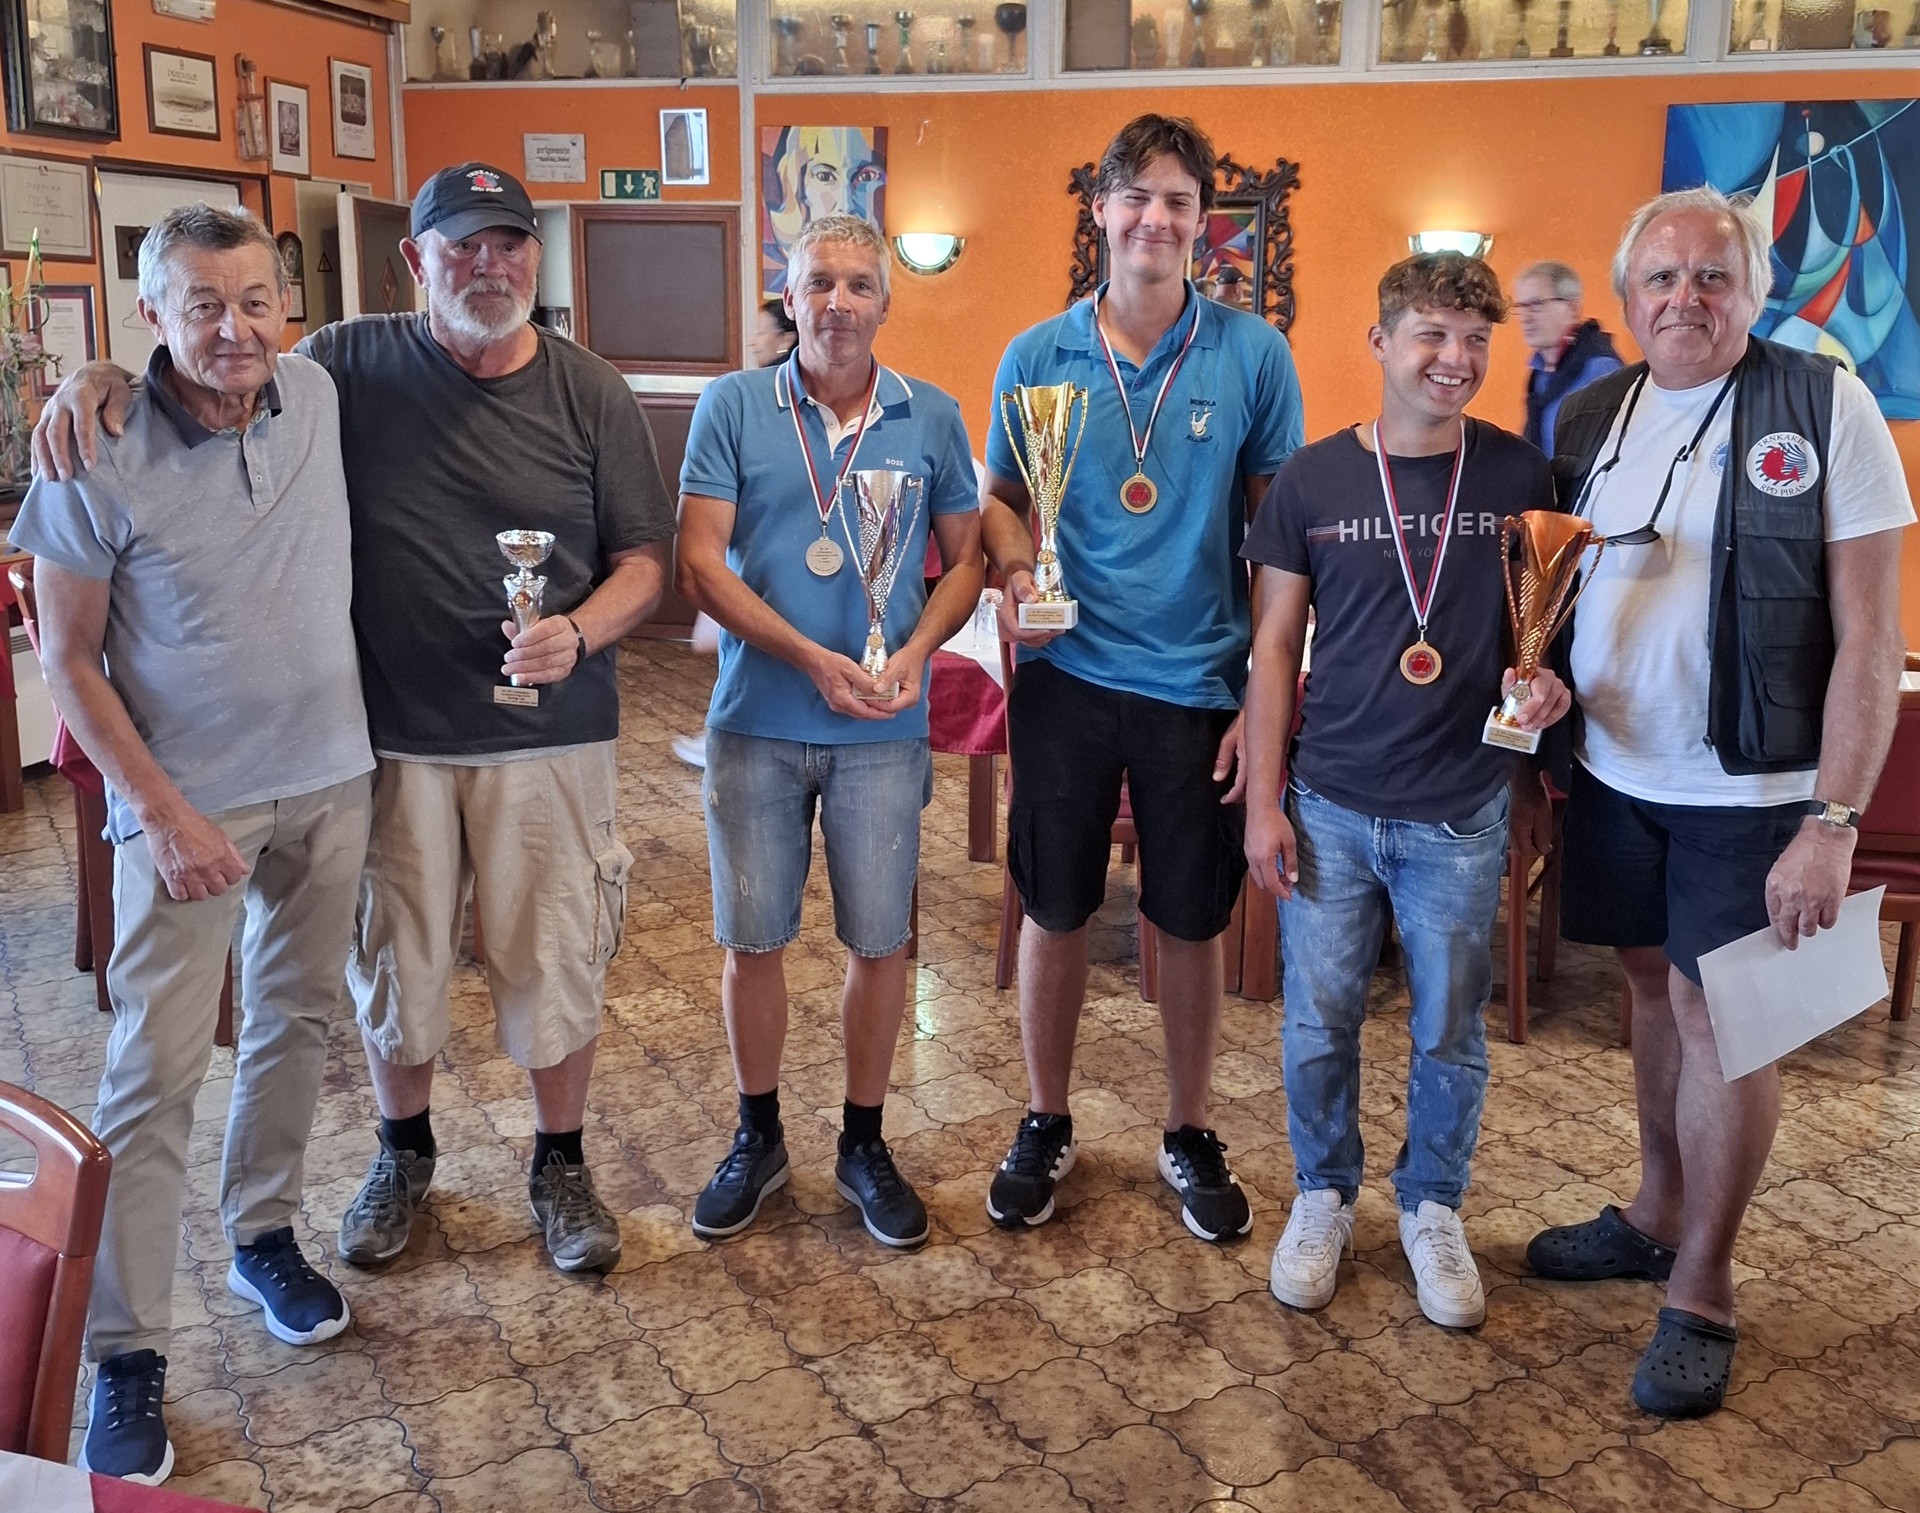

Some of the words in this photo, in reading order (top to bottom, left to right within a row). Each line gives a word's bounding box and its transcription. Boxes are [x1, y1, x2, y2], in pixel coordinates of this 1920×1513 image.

[1757, 434, 1805, 448] TRNKARJI
[885, 458, 904, 467] BOSS
[1760, 483, 1778, 495] RPD
[1780, 482, 1807, 496] PIRAN
[1383, 548, 1412, 559] NE
